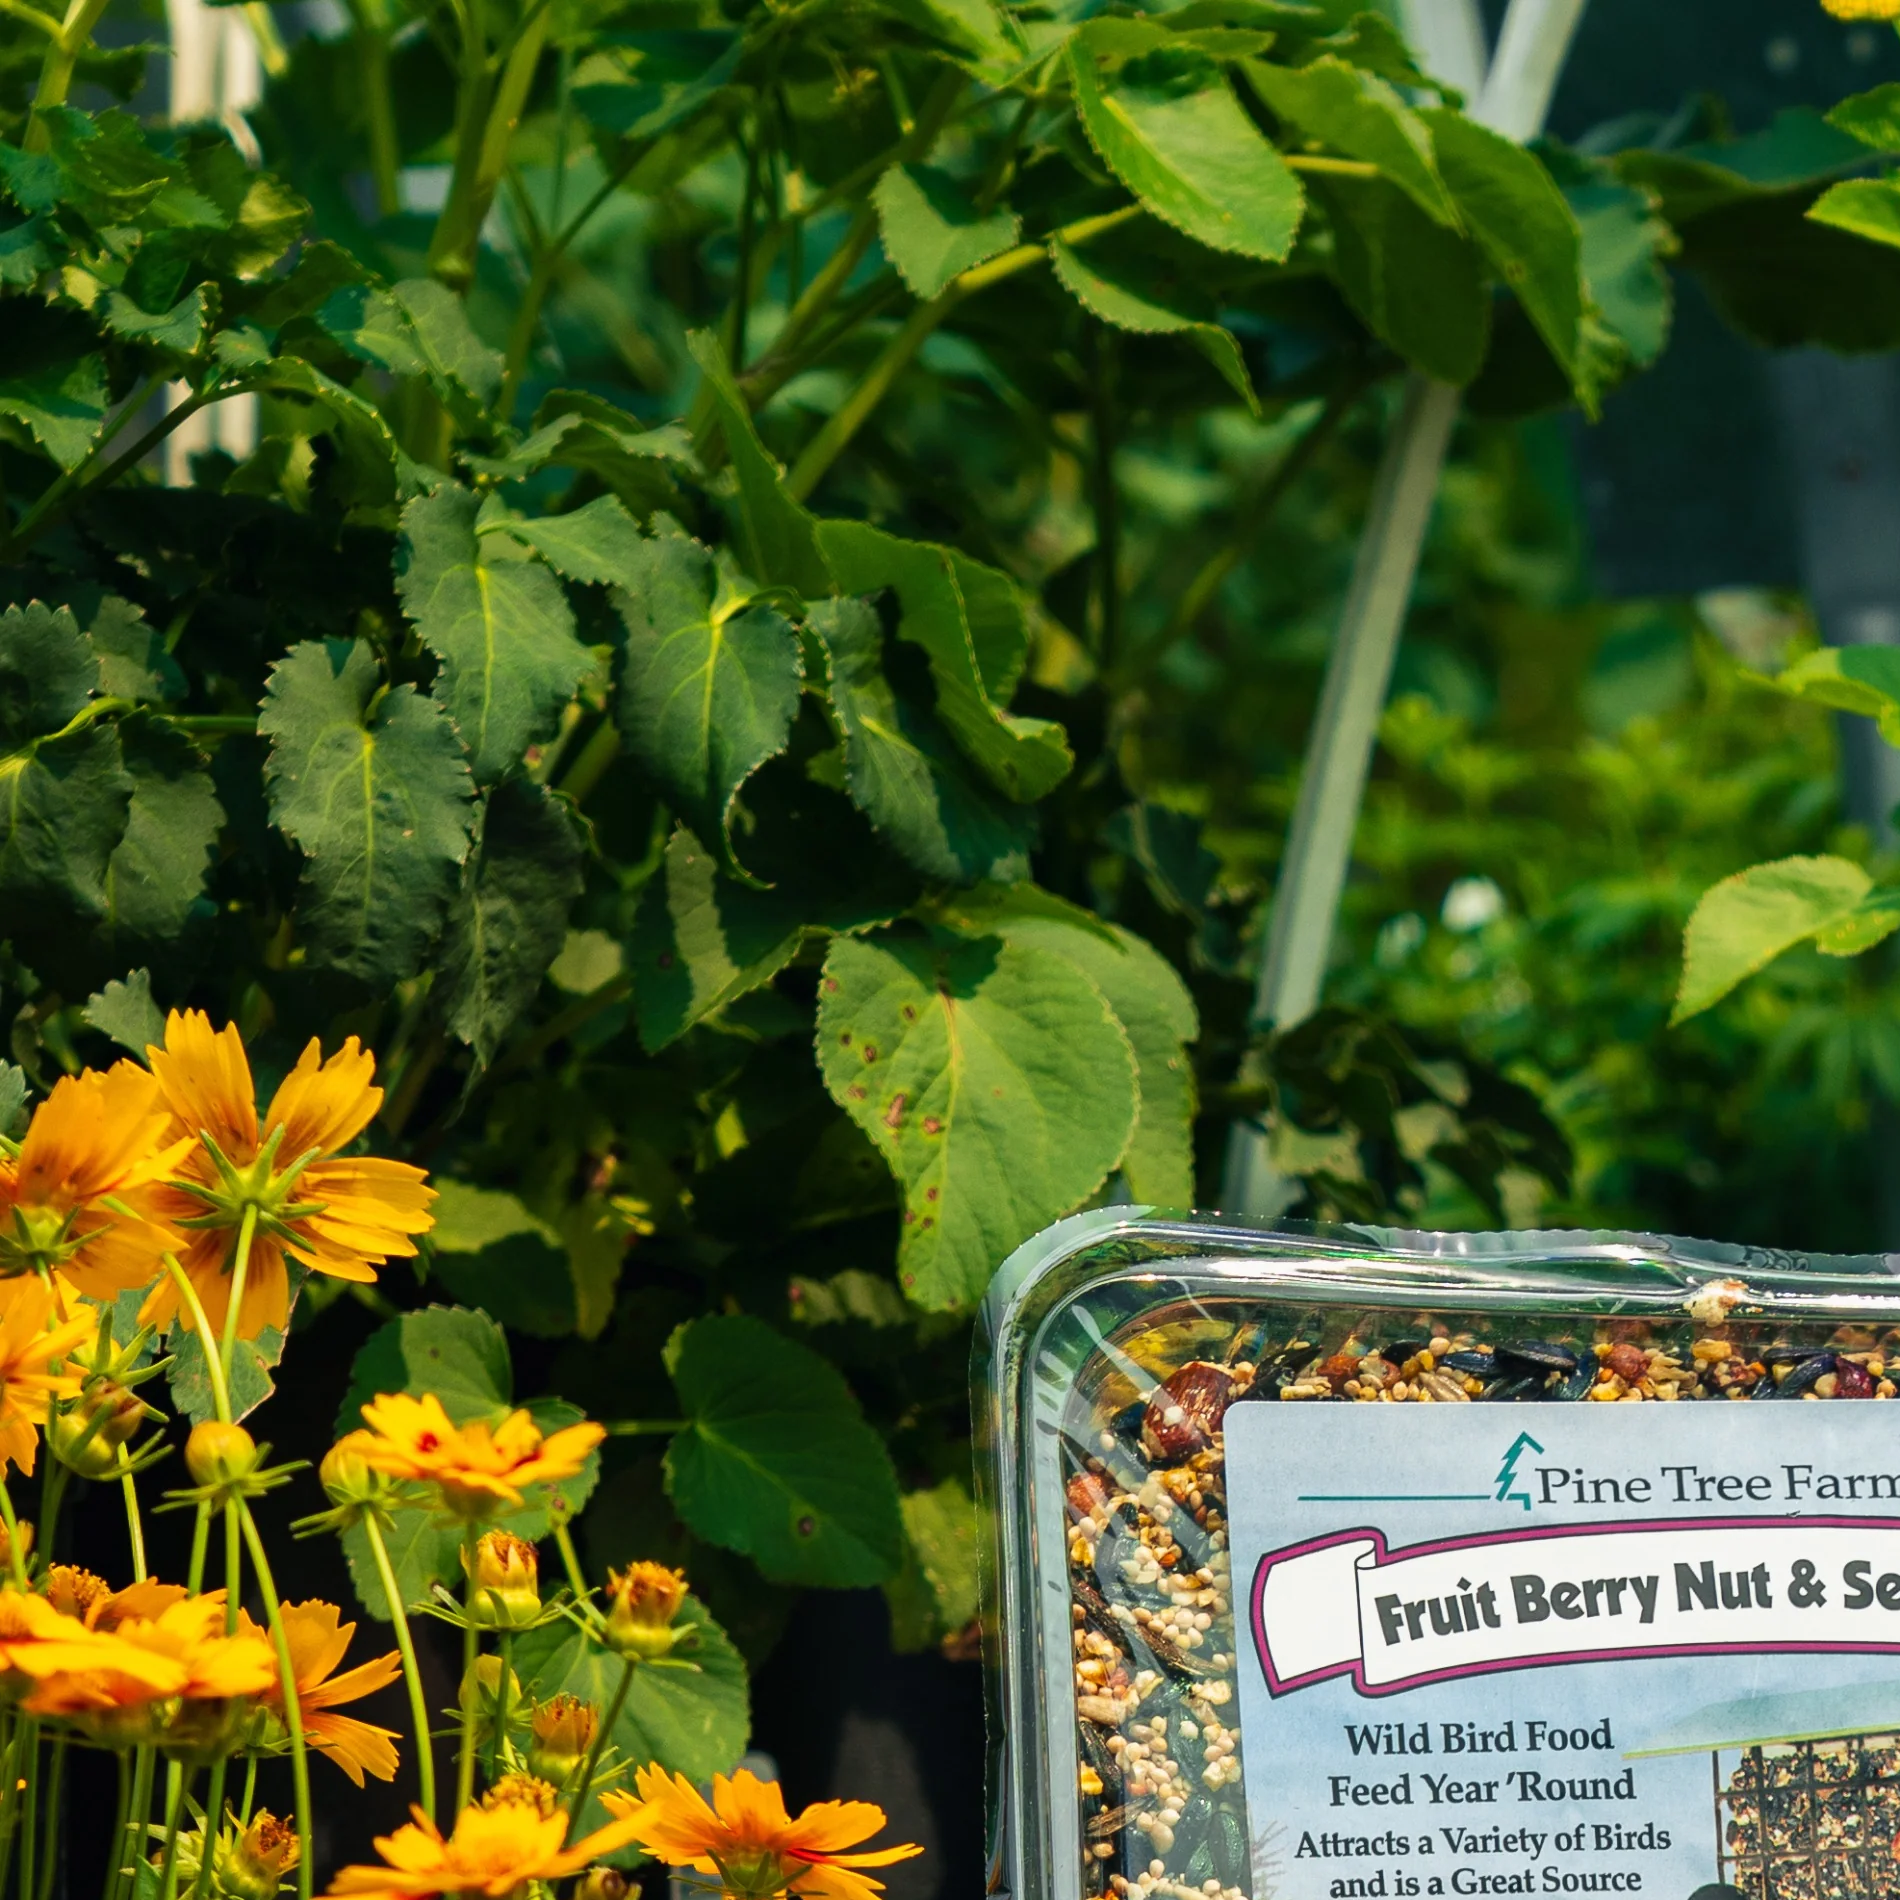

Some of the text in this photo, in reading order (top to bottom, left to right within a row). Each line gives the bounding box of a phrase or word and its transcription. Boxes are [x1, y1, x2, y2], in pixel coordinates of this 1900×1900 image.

[1535, 1467, 1651, 1503] Pine
[1661, 1465, 1771, 1502] Tree
[1374, 1577, 1501, 1646] Fruit
[1510, 1574, 1659, 1624] Berry
[1674, 1561, 1772, 1612] Nut
[1787, 1559, 1827, 1608] &
[1344, 1718, 1614, 1755] Wild Bird Food
[1328, 1773, 1414, 1806] Feed
[1420, 1773, 1499, 1803] Year
[1295, 1822, 1672, 1860] Attracts a Variety of Birds
[1330, 1866, 1642, 1898] and is a Great Source
